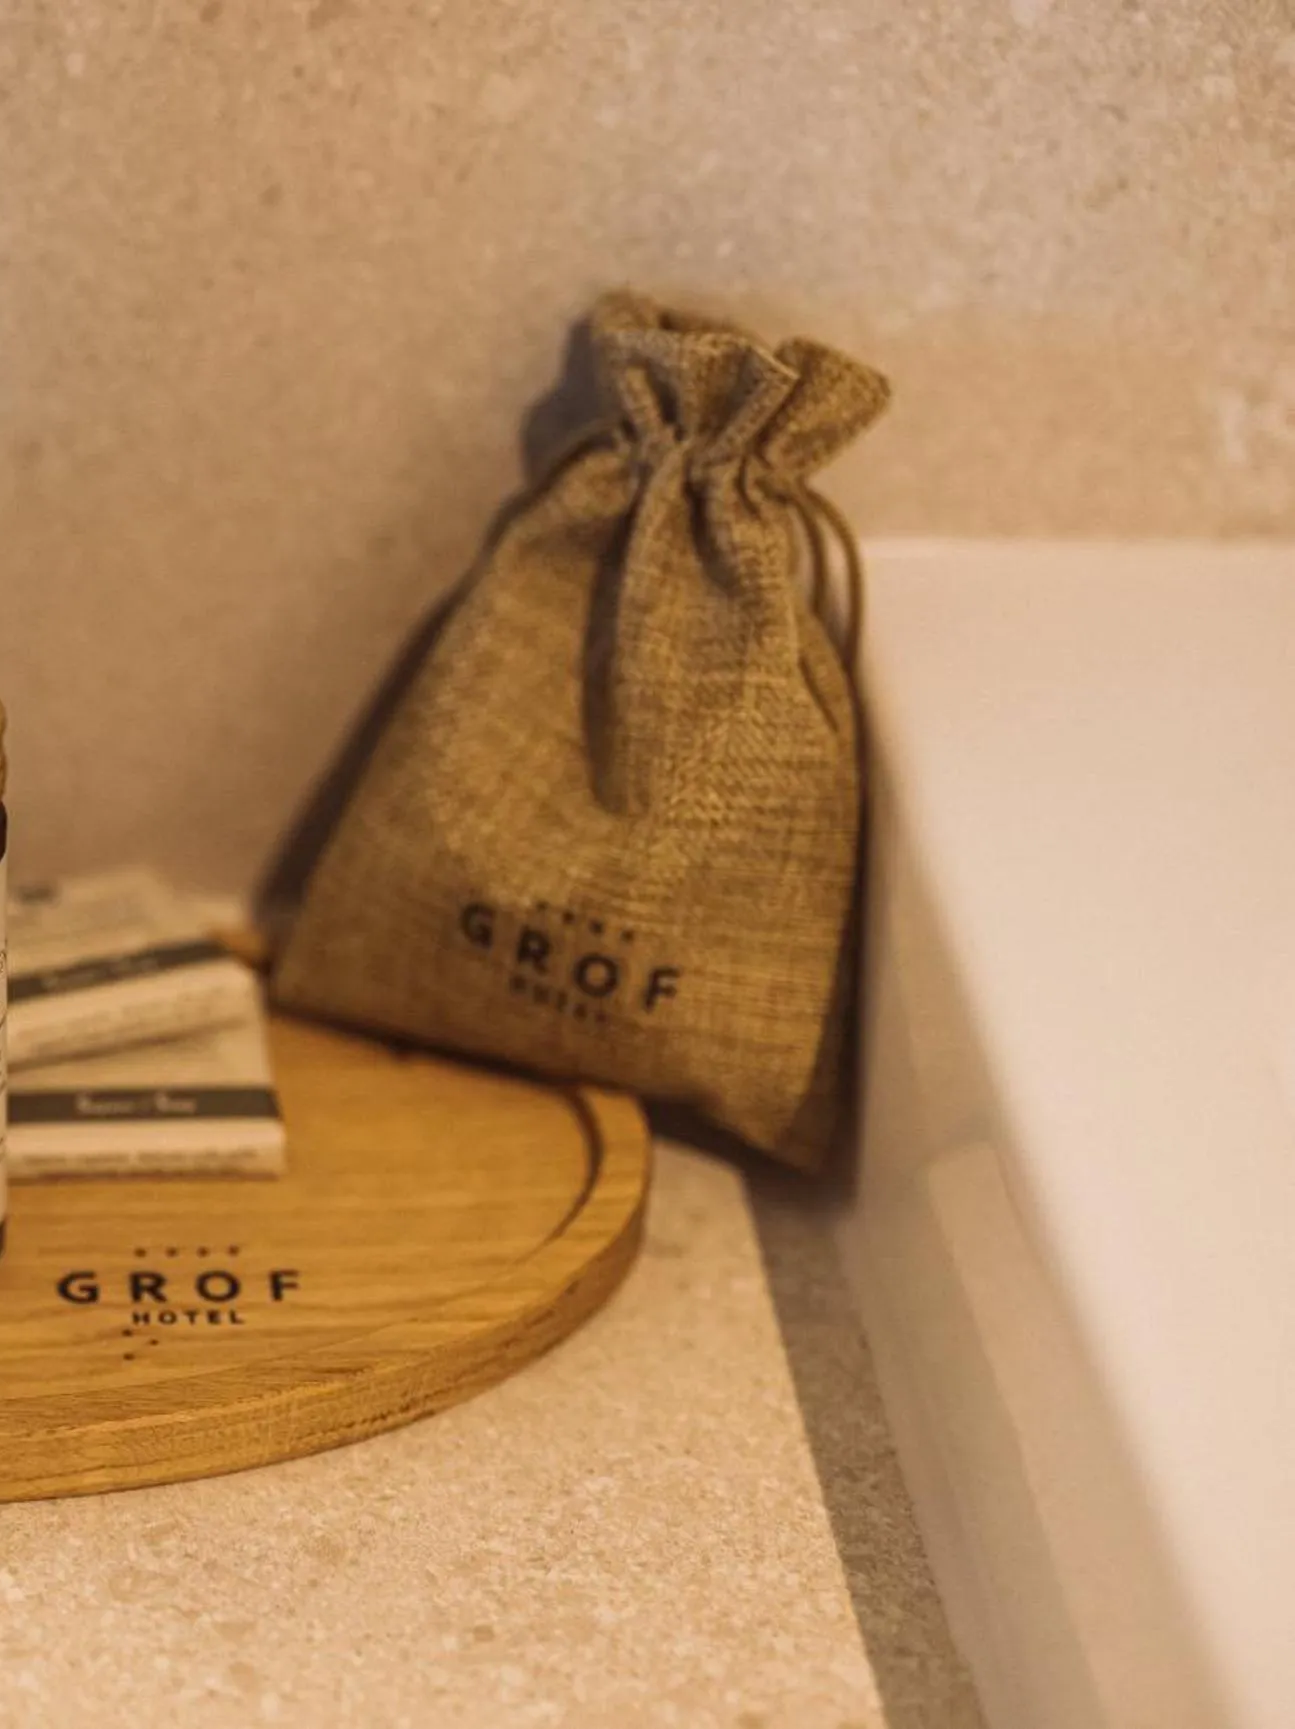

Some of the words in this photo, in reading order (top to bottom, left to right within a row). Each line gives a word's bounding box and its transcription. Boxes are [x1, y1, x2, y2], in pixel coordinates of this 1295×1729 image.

[461, 902, 682, 1014] GROF
[56, 1268, 301, 1304] GROF
[131, 1308, 246, 1326] HOTEL
